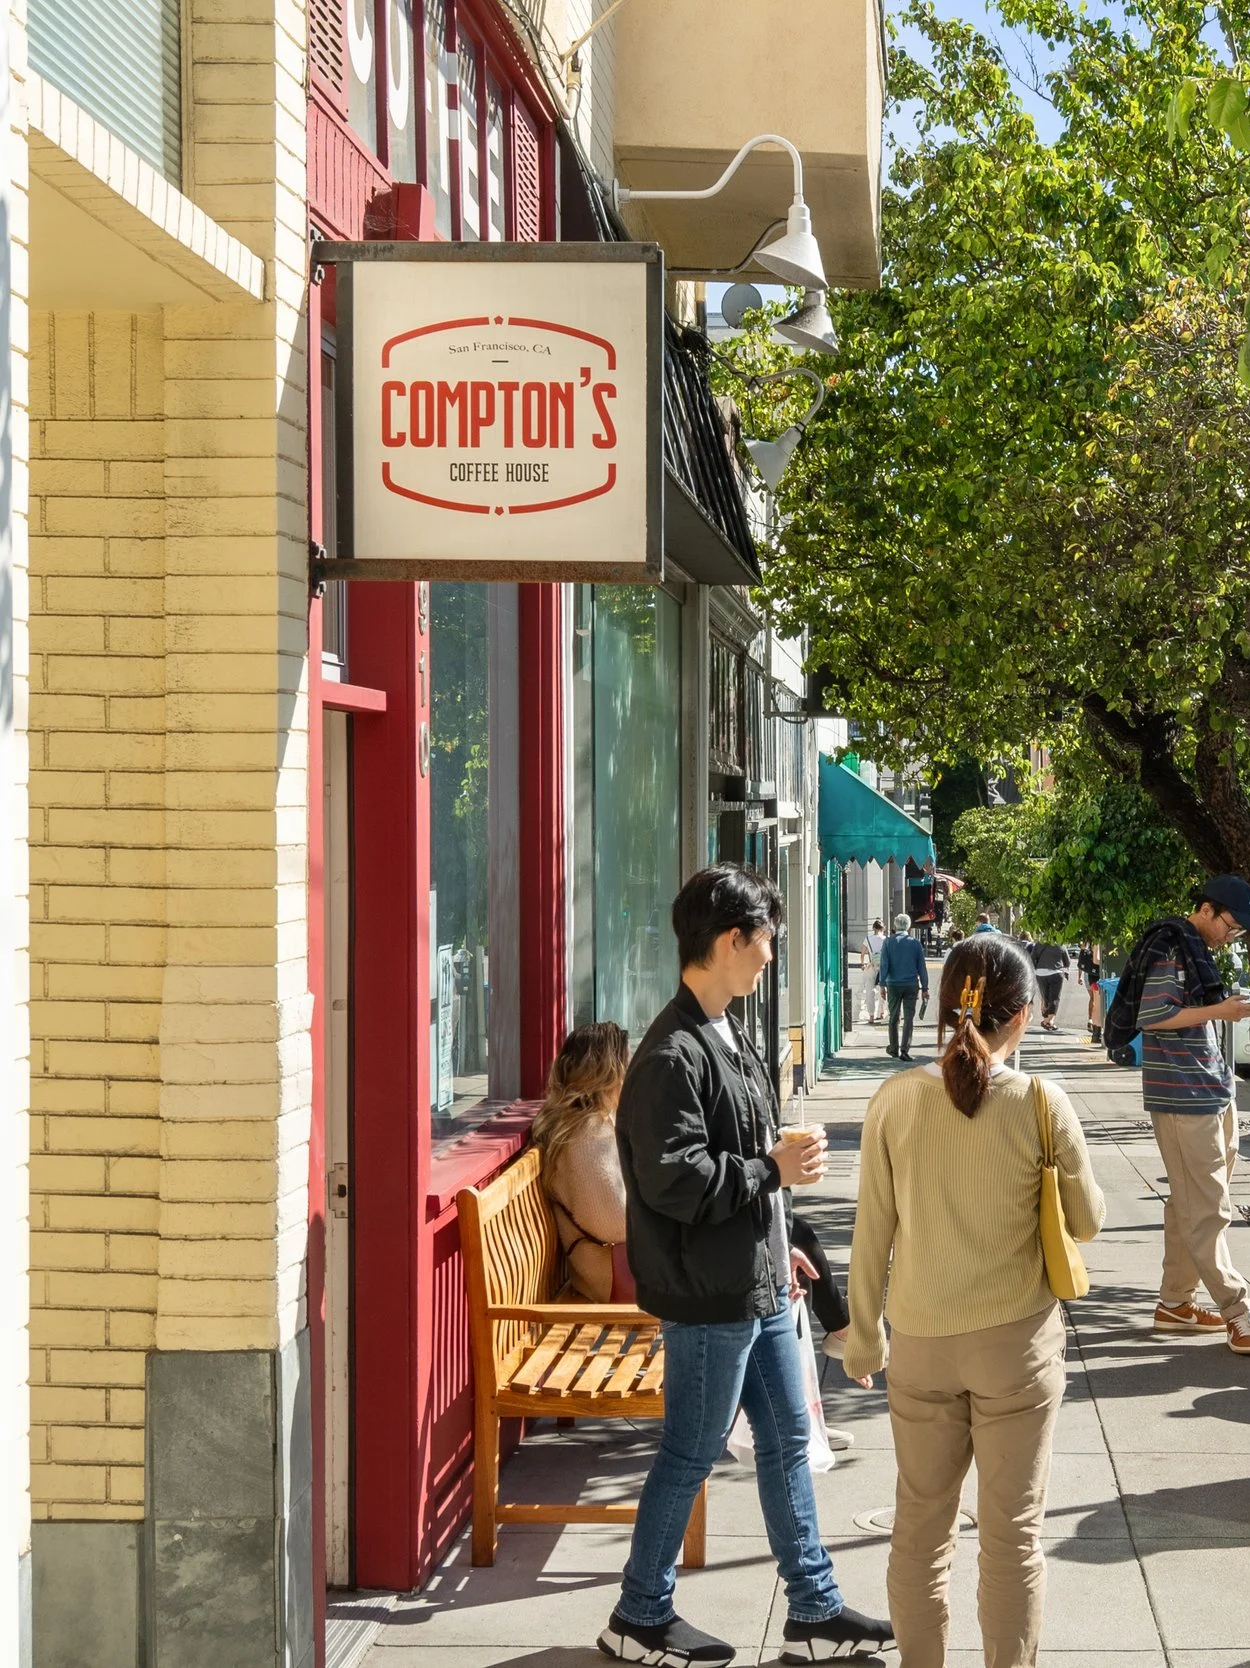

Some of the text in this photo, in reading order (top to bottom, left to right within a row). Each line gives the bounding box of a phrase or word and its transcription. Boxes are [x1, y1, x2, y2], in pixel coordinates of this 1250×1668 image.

[448, 345, 470, 355] San
[532, 344, 552, 356] CA
[381, 366, 617, 449] COMPTON'S
[449, 462, 549, 483] COFFEE HOUSE
